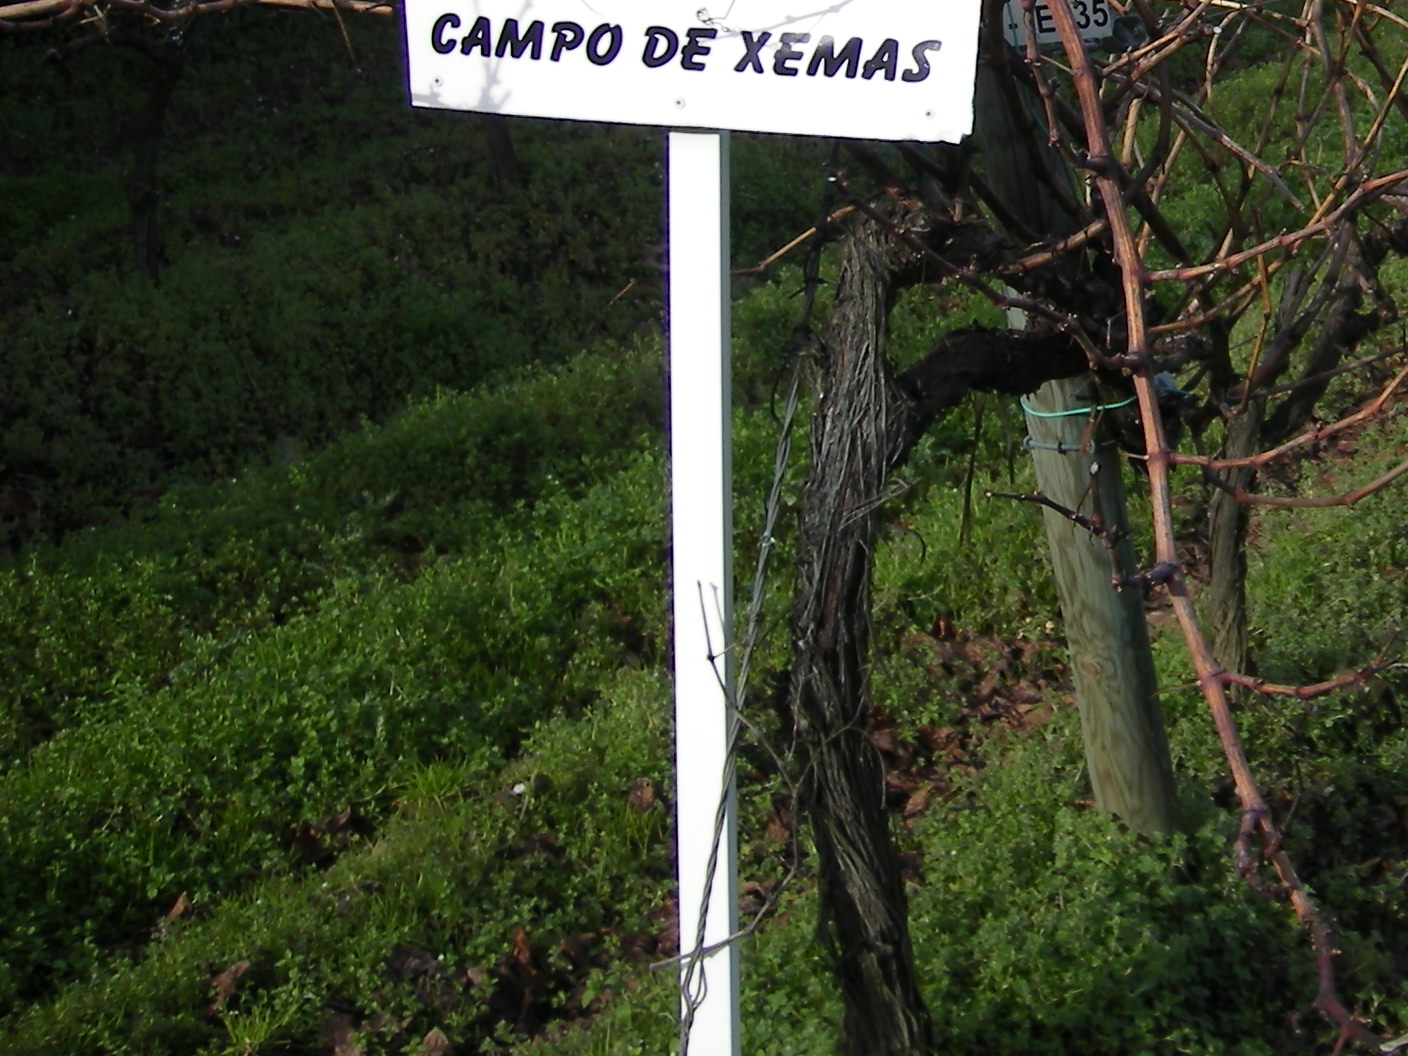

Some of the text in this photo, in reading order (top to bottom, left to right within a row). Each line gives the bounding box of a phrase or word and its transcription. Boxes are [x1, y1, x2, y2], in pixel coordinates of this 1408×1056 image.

[430, 12, 942, 83] CAMPO DE XEMAS
